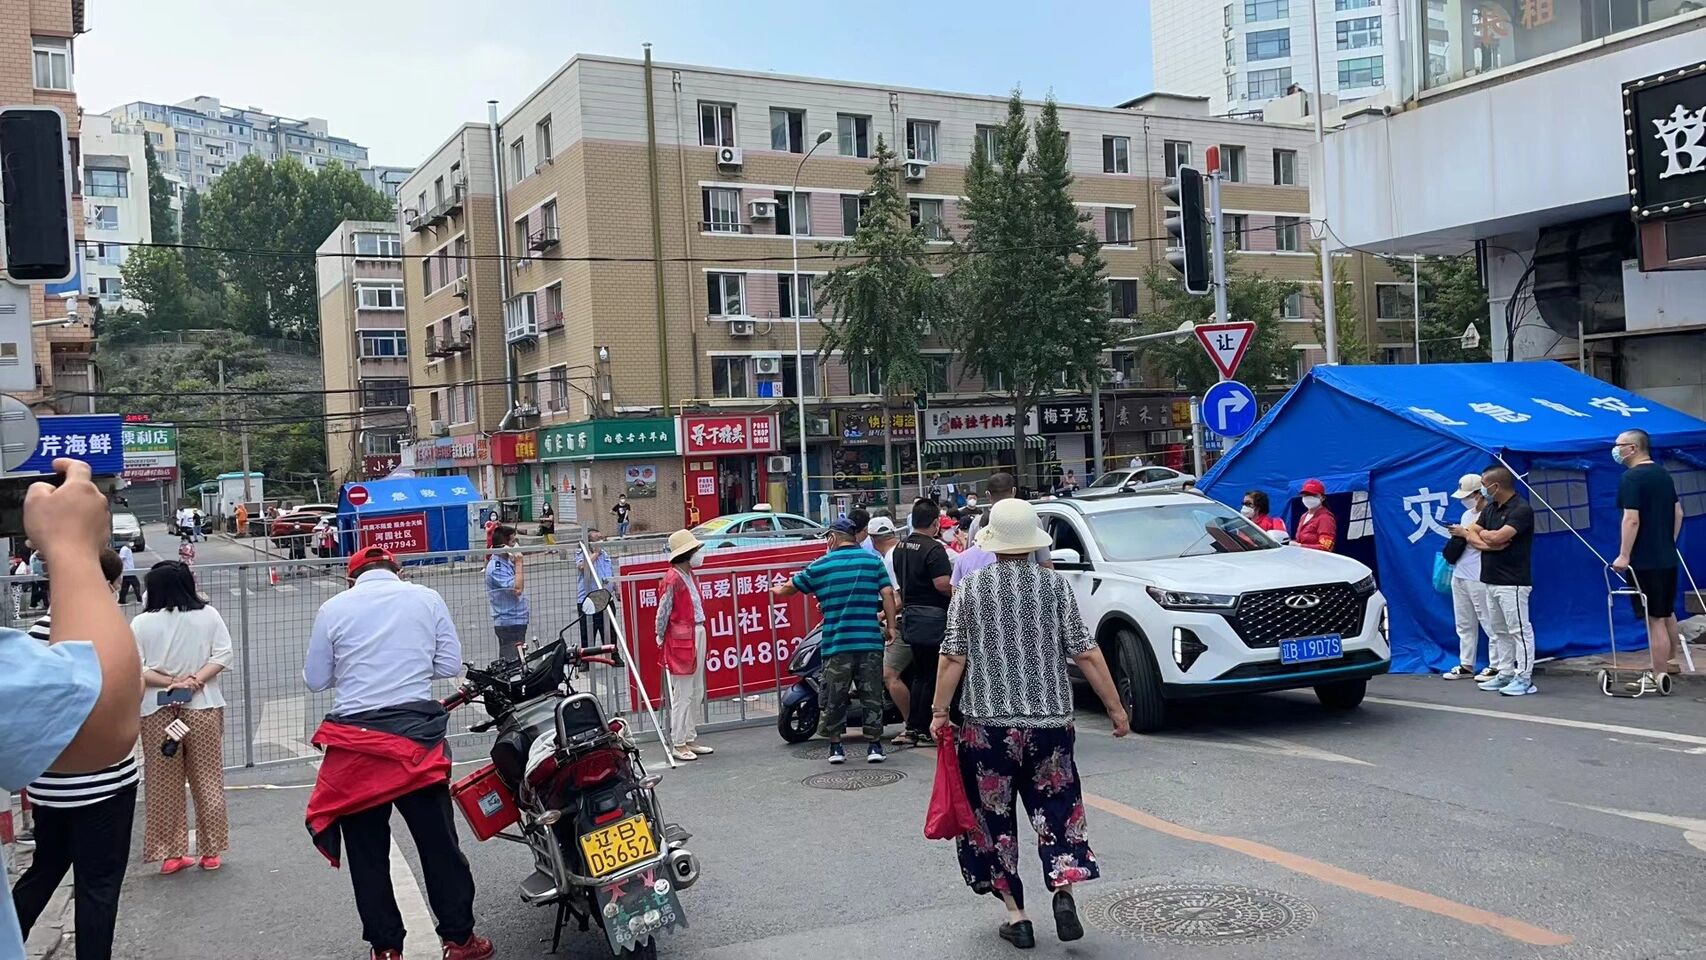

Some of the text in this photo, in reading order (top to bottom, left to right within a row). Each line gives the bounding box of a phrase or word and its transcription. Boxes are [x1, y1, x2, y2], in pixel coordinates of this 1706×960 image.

[1216, 334, 1235, 350] 让
[122, 430, 168, 446] 便利店
[604, 431, 669, 444] 内蒙古牛羊肉
[365, 487, 468, 504] 急救灾
[1403, 487, 1452, 544] 灾
[711, 603, 791, 637] 山社区
[591, 835, 653, 874] D5652
